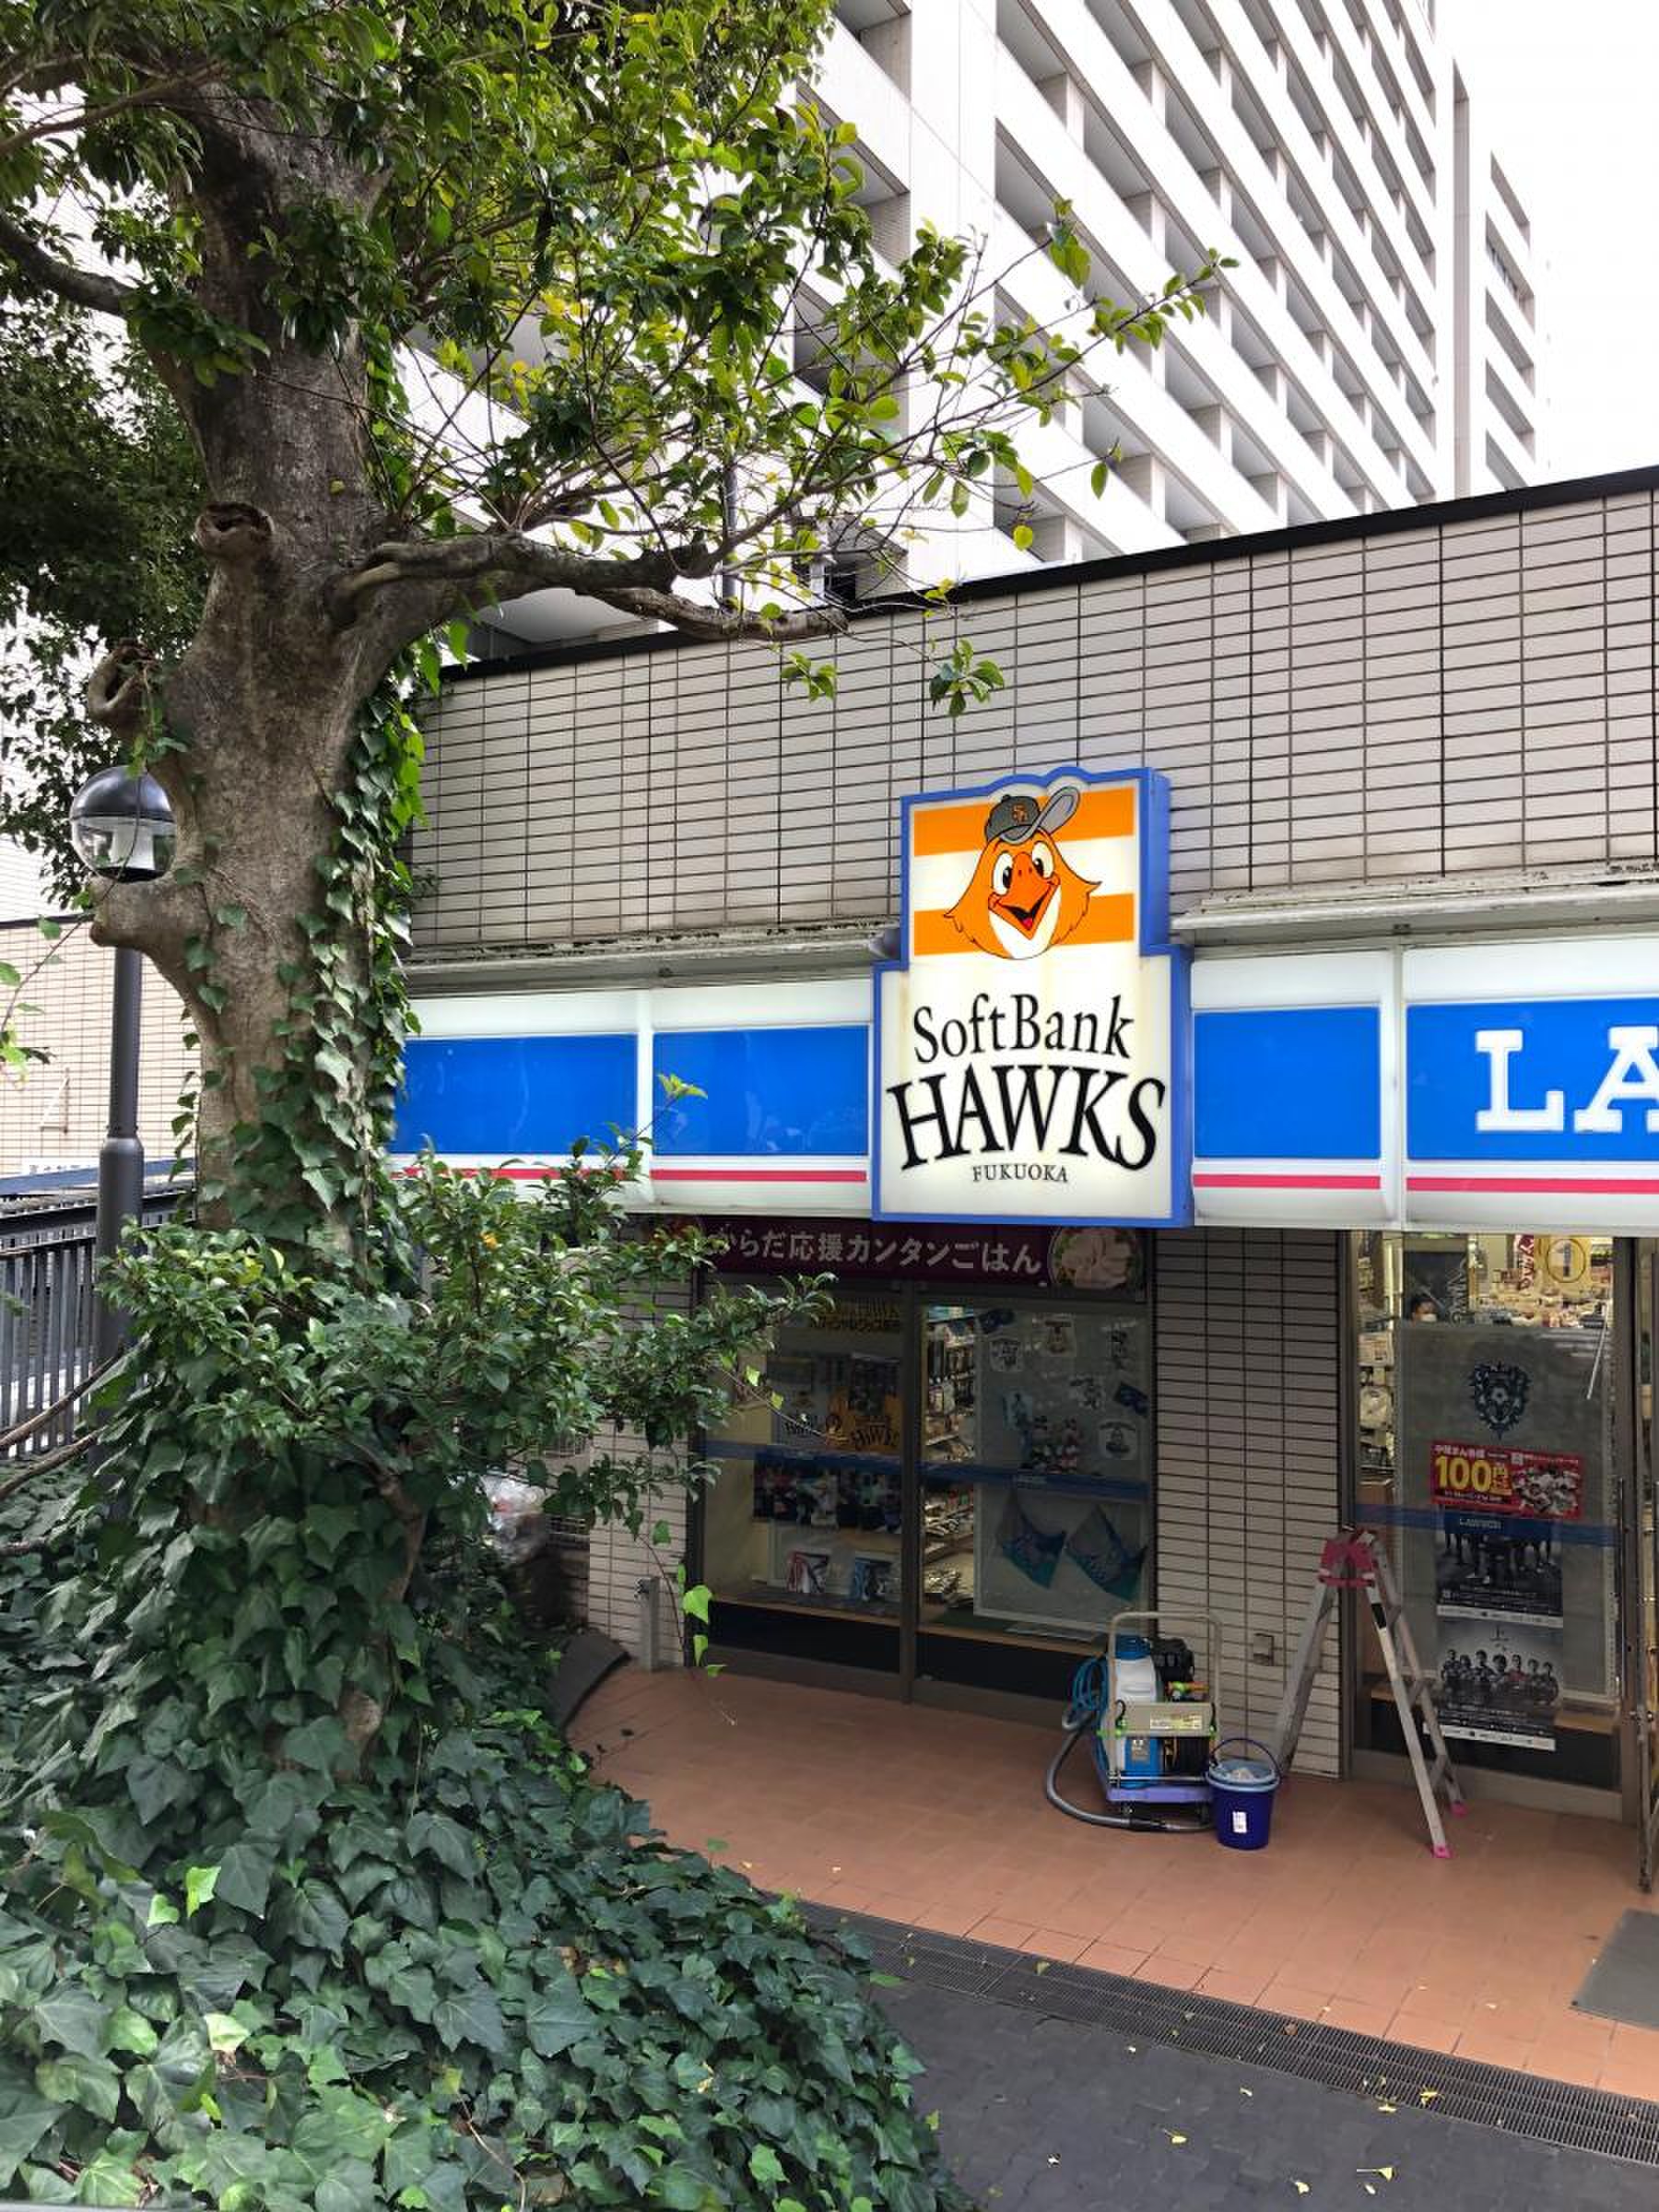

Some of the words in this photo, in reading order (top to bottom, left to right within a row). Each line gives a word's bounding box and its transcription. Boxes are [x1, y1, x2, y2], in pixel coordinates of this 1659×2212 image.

[912, 993, 1135, 1064] SoftBank
[887, 1061, 1166, 1171] HAWKS
[972, 1163, 1069, 1183] FUKUOKA
